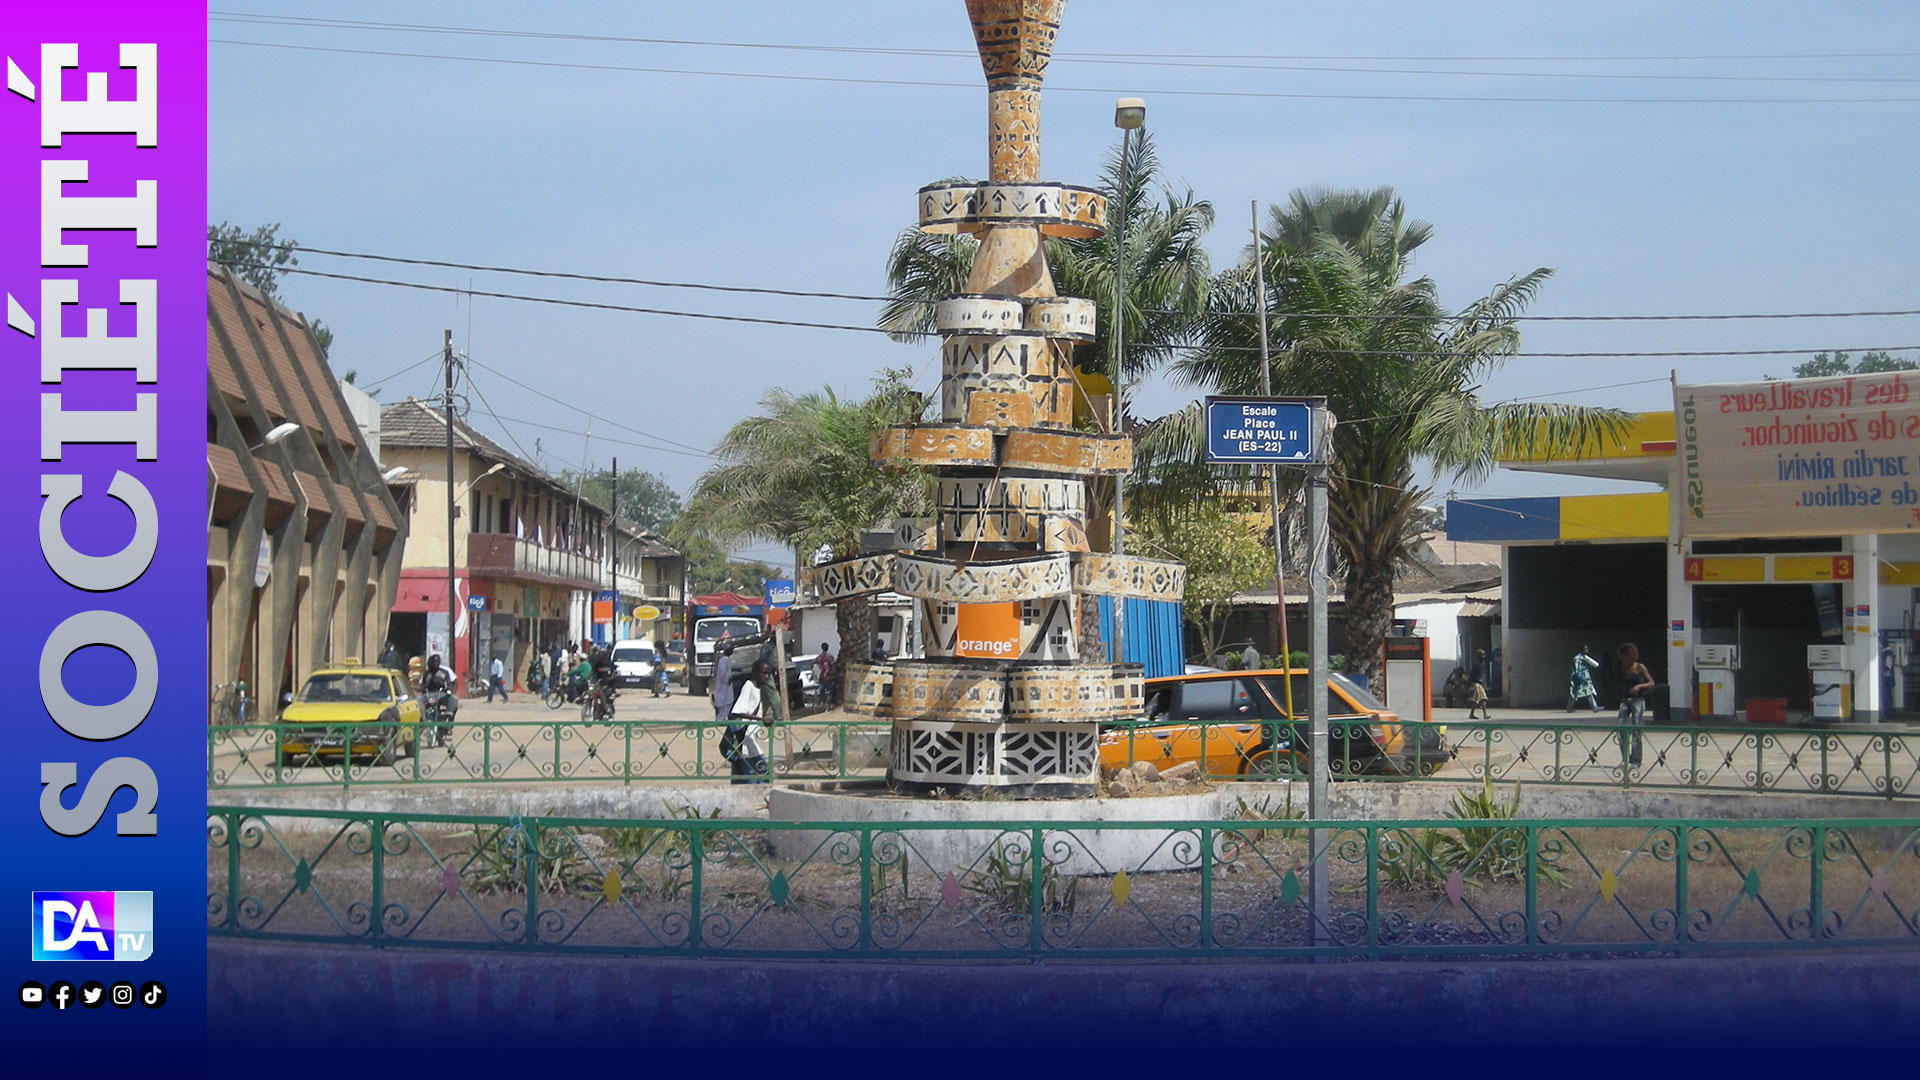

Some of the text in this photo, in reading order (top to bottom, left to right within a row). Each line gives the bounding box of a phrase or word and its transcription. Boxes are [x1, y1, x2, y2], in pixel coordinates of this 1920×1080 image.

[1242, 405, 1277, 416] Escale
[1244, 418, 1276, 429] Place
[1222, 429, 1297, 440] JEAN PAUL II
[1238, 441, 1282, 453] (ES-22)
[1689, 561, 1699, 576] 4
[1838, 559, 1850, 576] 3
[959, 639, 1012, 655] orange
